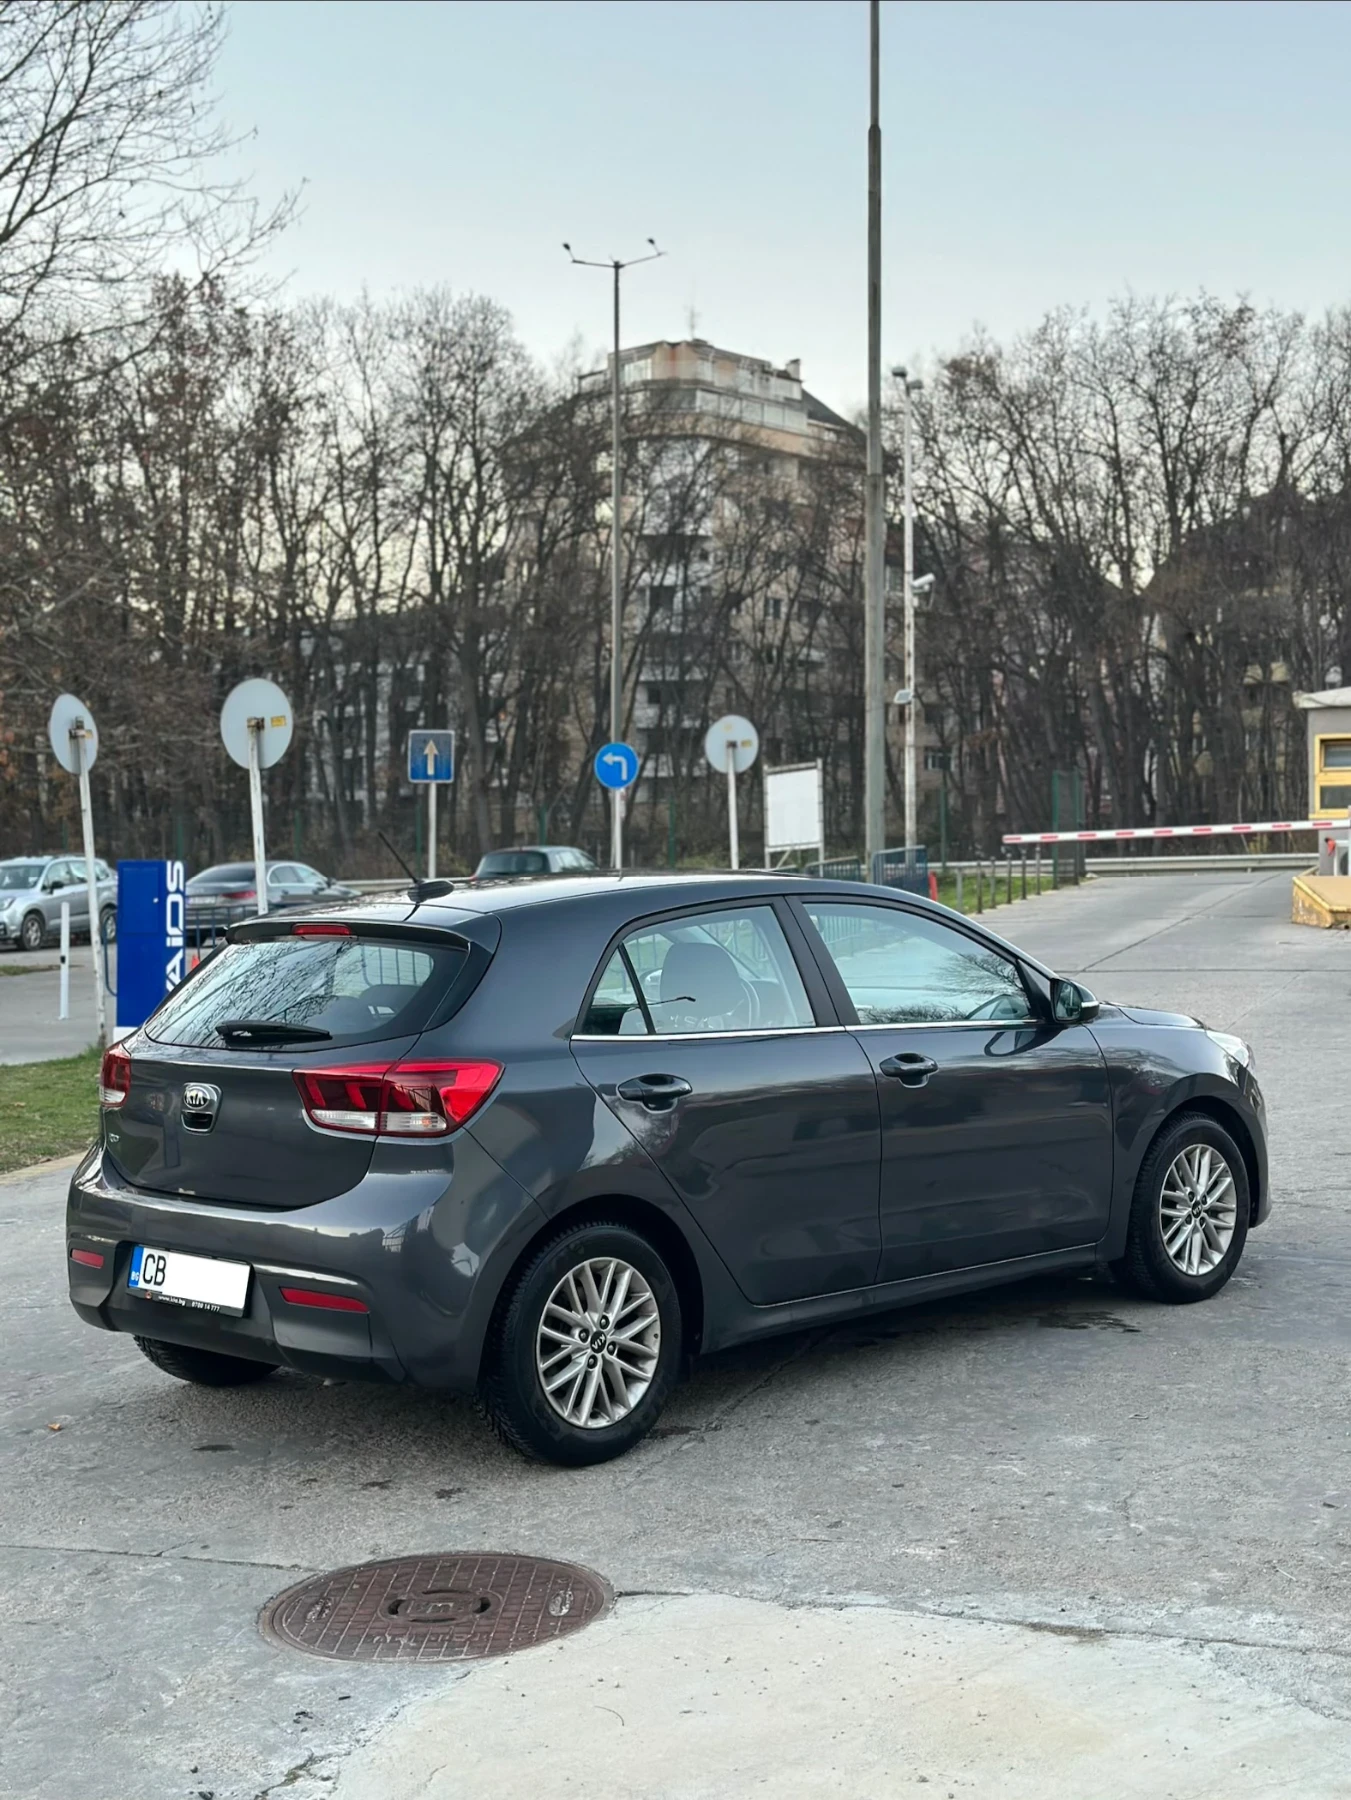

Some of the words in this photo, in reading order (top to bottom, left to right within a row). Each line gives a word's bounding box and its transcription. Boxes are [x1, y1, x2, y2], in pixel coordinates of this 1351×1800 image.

[165, 860, 184, 992] AiOS
[186, 1089, 205, 1105] KIA
[131, 1271, 140, 1281] BG
[143, 1253, 167, 1286] CB
[592, 1333, 605, 1349] KIA
